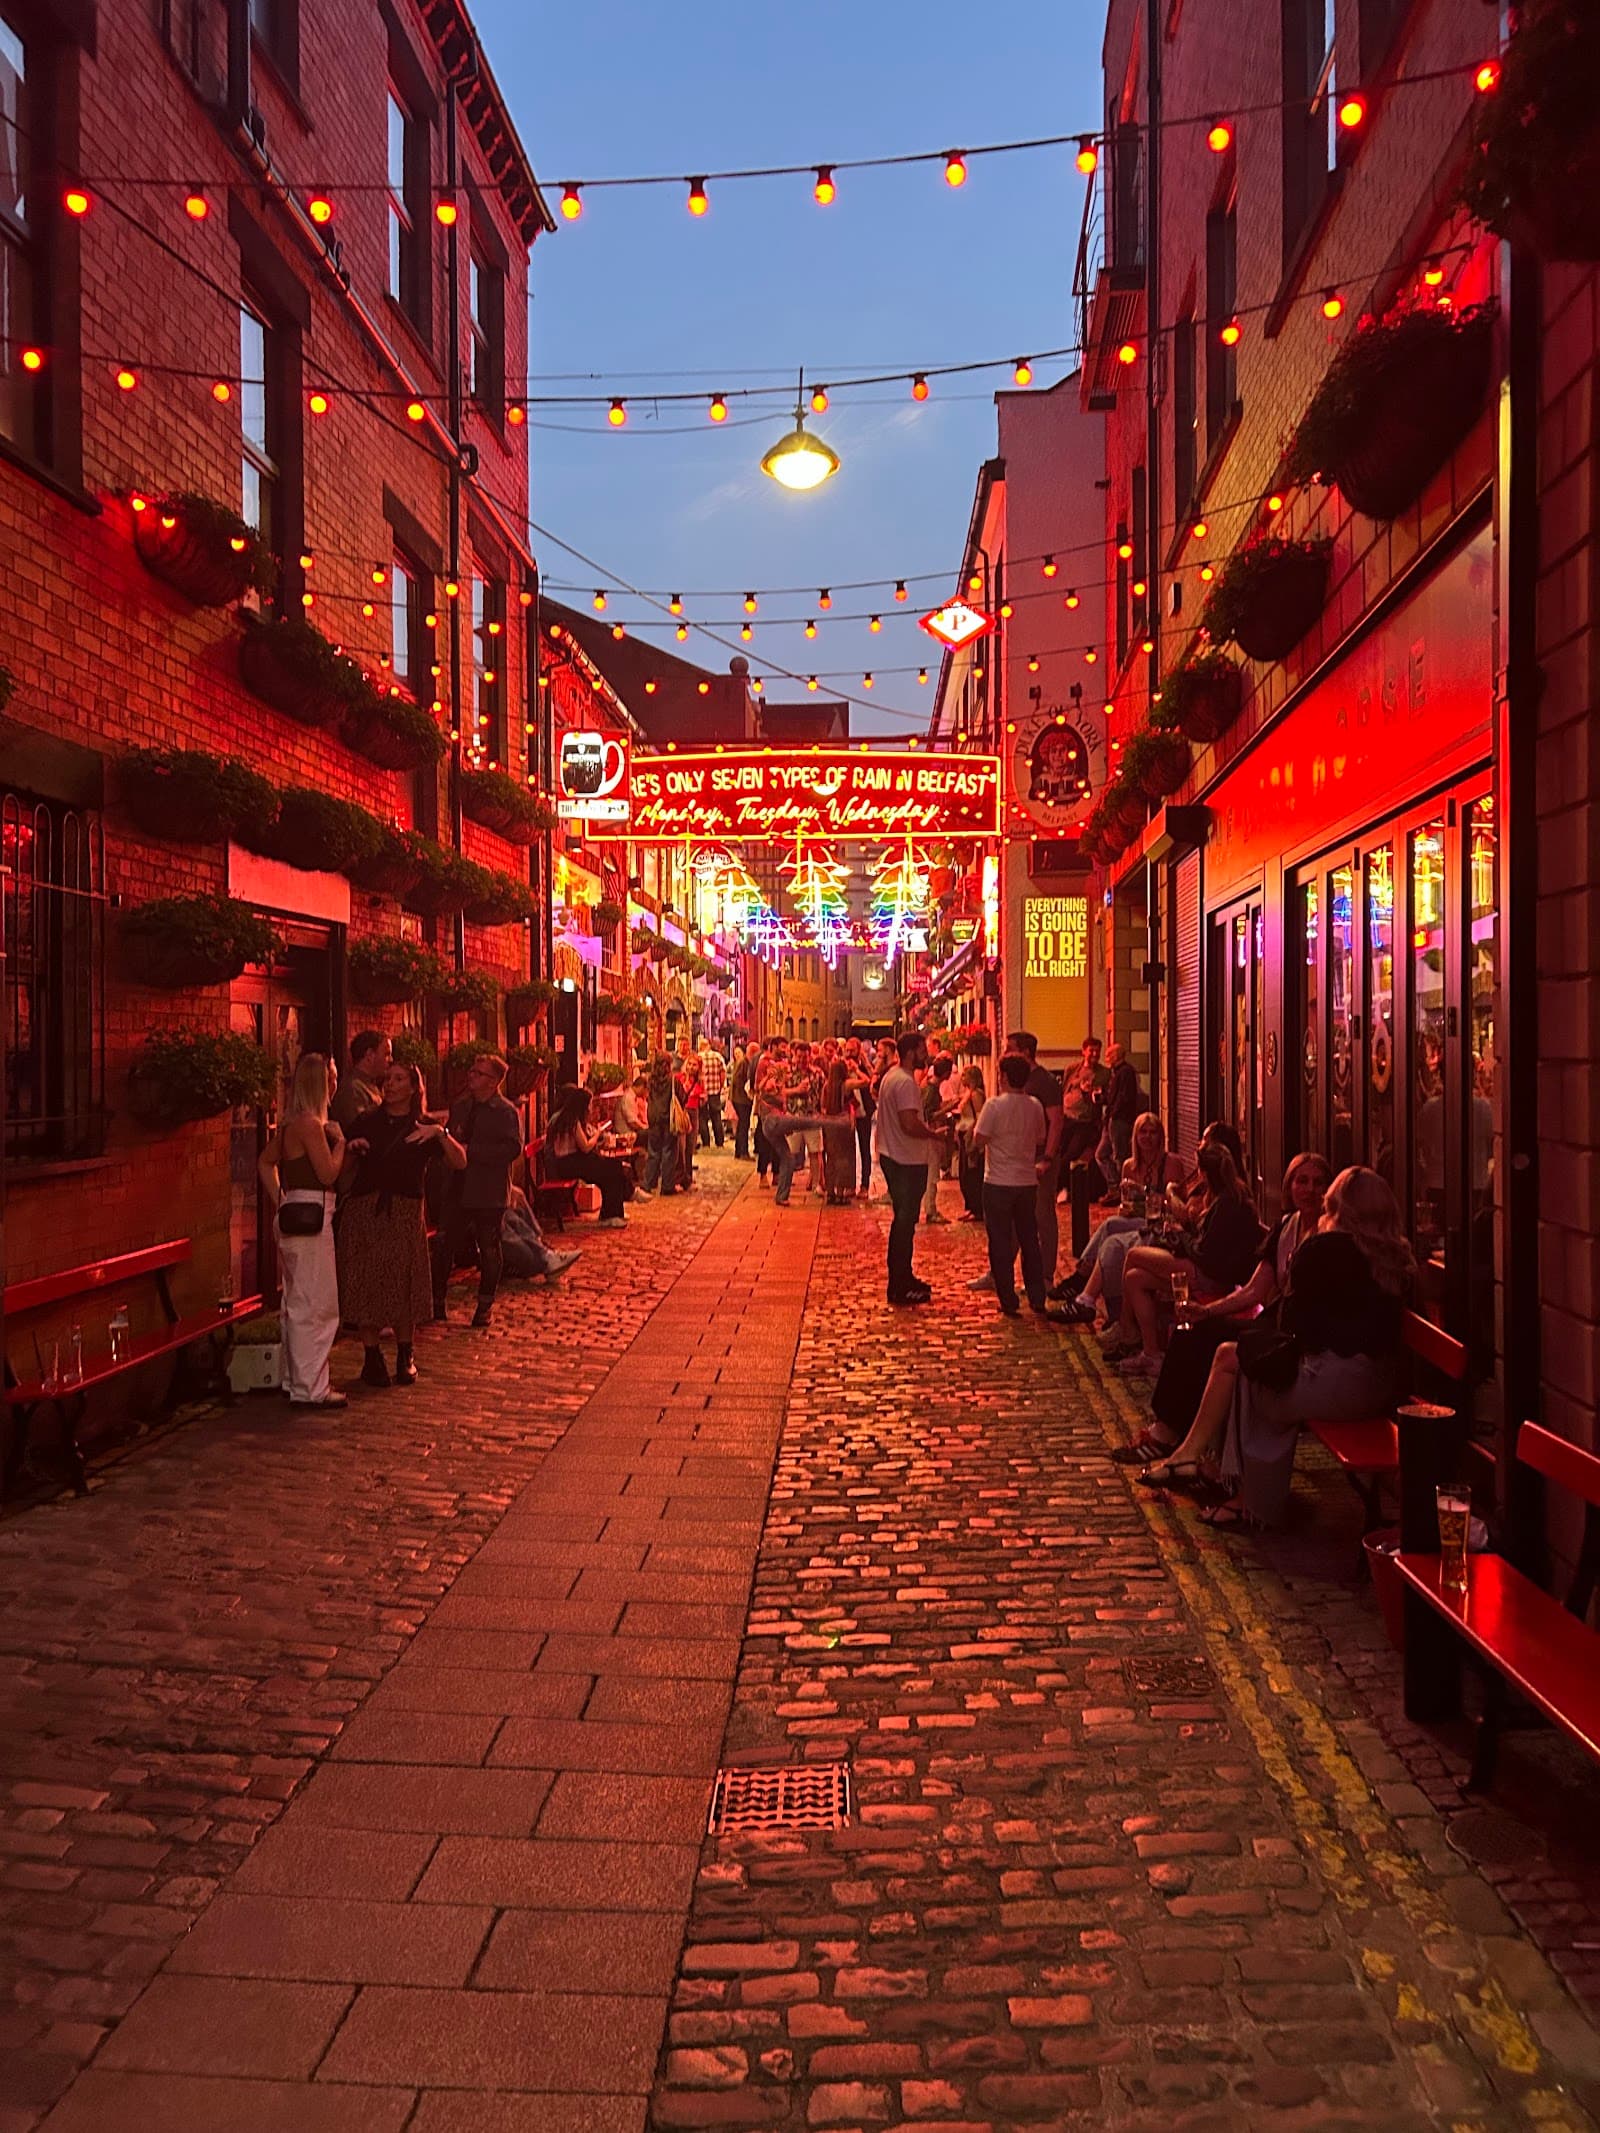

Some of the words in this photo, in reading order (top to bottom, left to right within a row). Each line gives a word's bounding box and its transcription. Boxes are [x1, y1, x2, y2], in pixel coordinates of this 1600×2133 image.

[1074, 707, 1104, 754] YORK
[666, 769, 705, 794] ONLY
[711, 767, 764, 791] SEVEN
[769, 766, 820, 789] TYPES
[825, 766, 848, 788] OF
[852, 766, 892, 790] RAIN
[895, 769, 913, 791] IN
[1024, 897, 1087, 912] EVERYTHING
[1025, 912, 1039, 931] IS
[1041, 912, 1087, 932] GOING
[1025, 931, 1054, 960] TO
[1059, 931, 1087, 960] BE
[1025, 960, 1048, 977] ALL
[1049, 960, 1087, 977] RIGHT
